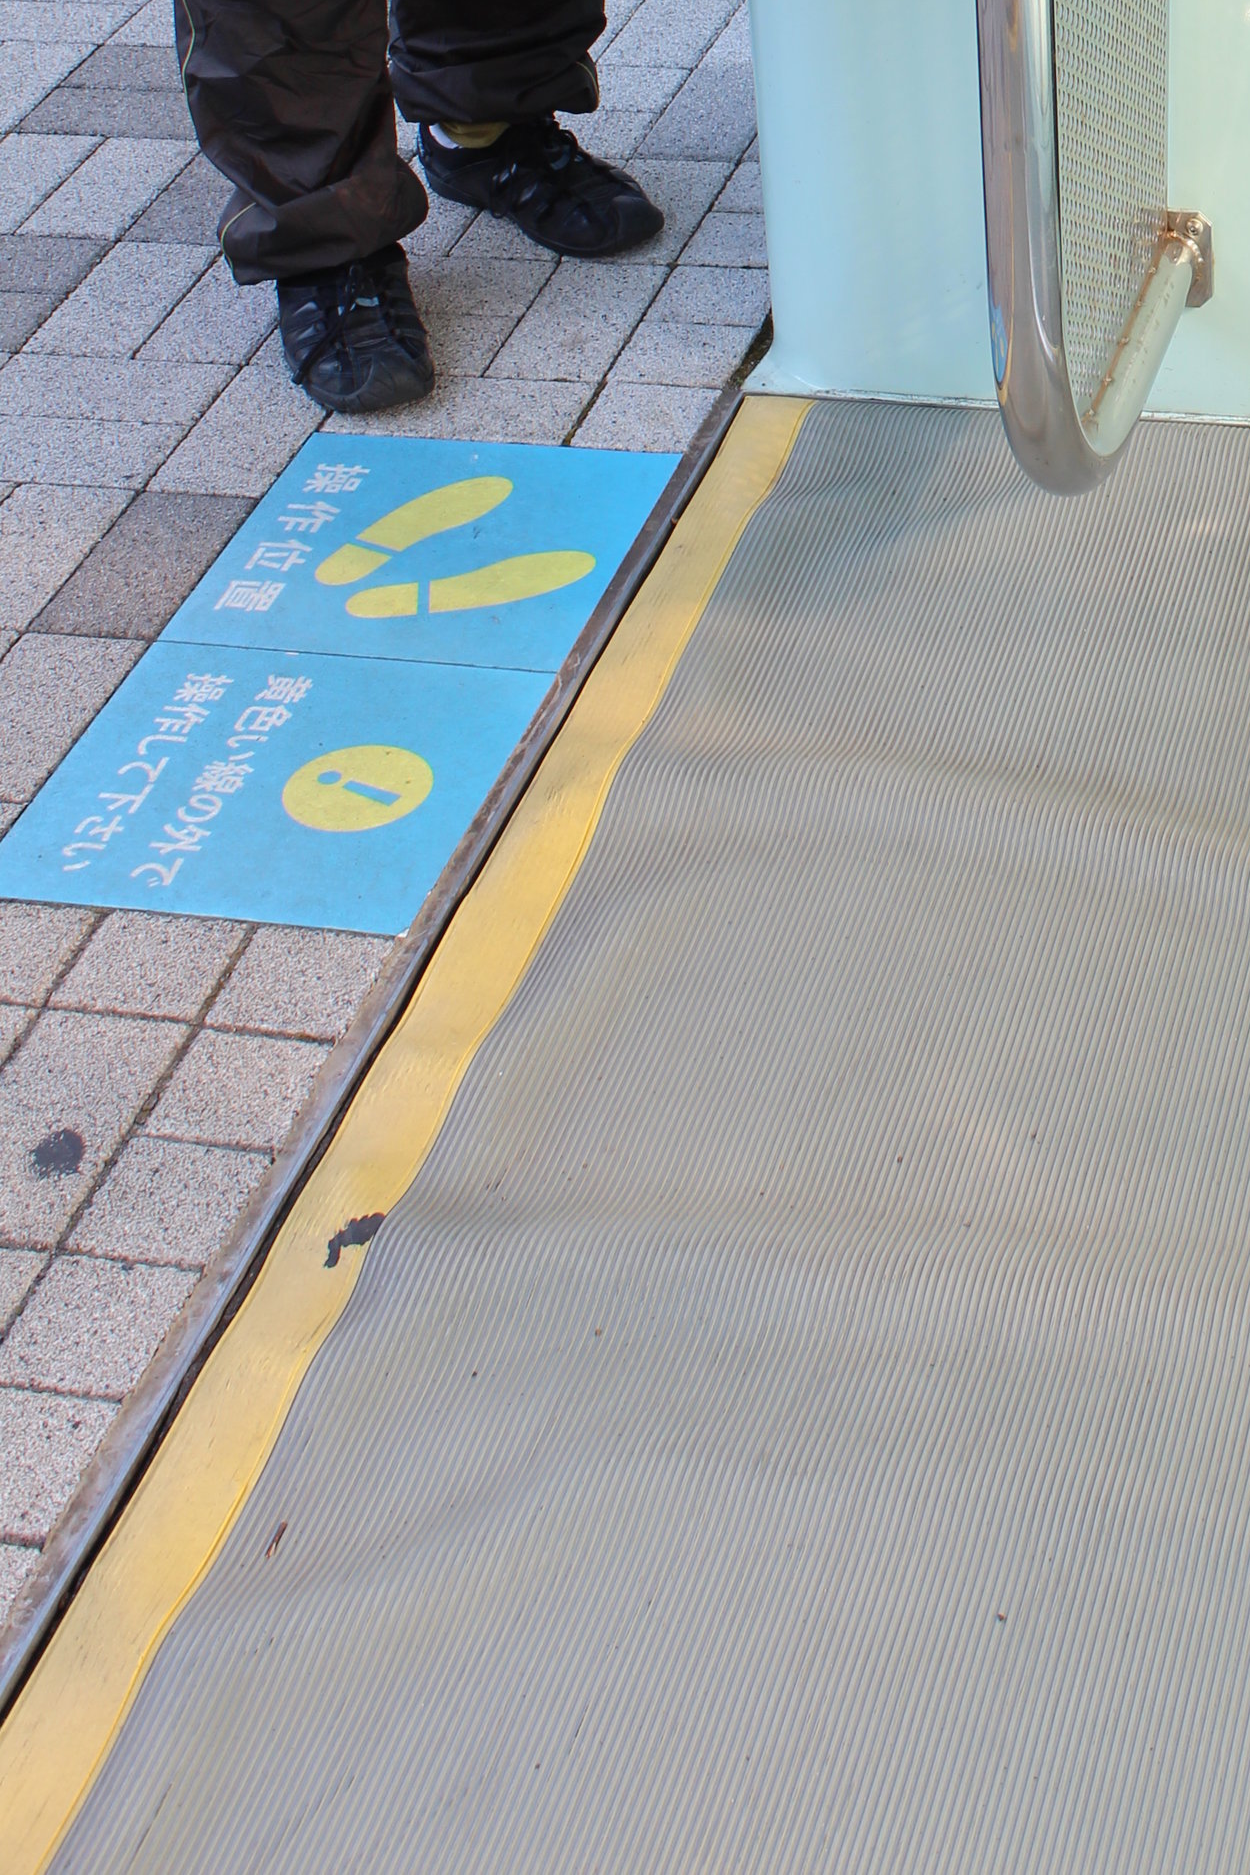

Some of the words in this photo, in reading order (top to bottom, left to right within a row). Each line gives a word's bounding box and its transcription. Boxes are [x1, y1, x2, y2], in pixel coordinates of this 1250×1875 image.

[213, 463, 370, 612] 操作位置
[62, 672, 234, 872] 操作して下さい
[130, 674, 313, 887] 黄色い線の外で
